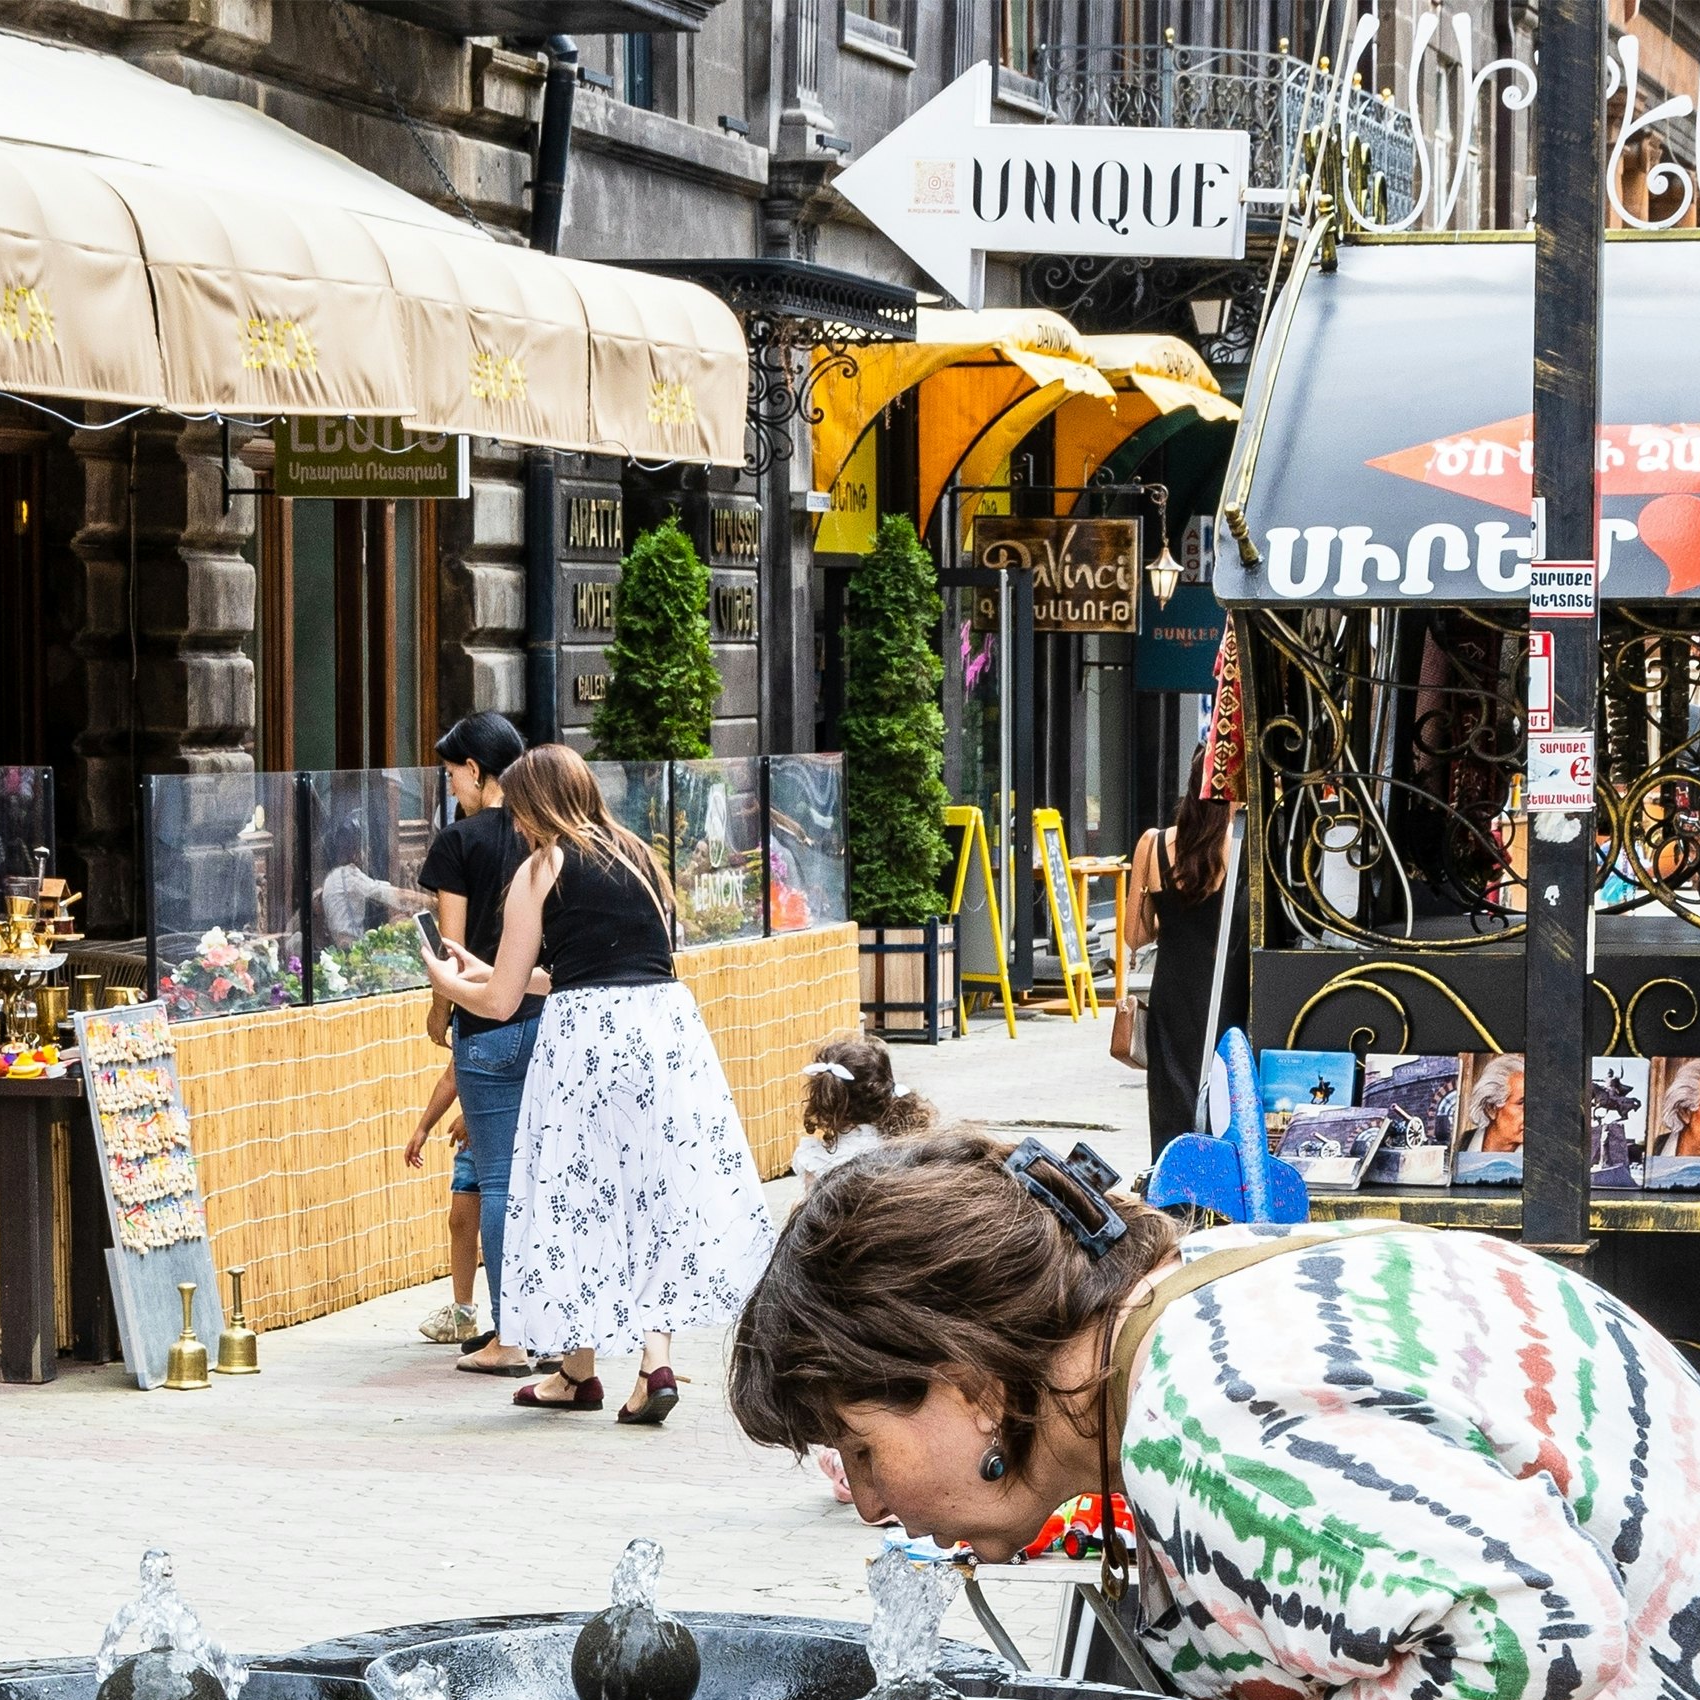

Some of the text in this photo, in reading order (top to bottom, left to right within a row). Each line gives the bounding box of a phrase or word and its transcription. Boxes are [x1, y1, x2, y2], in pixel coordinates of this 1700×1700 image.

[972, 157, 1230, 236] UNIQUE
[569, 498, 622, 548] ARATTA
[577, 582, 618, 628] HOTE
[1532, 593, 1593, 607] ԿԵՂՏՈՏԵ
[1153, 627, 1220, 641] BUNKER
[694, 869, 744, 912] LEMON
